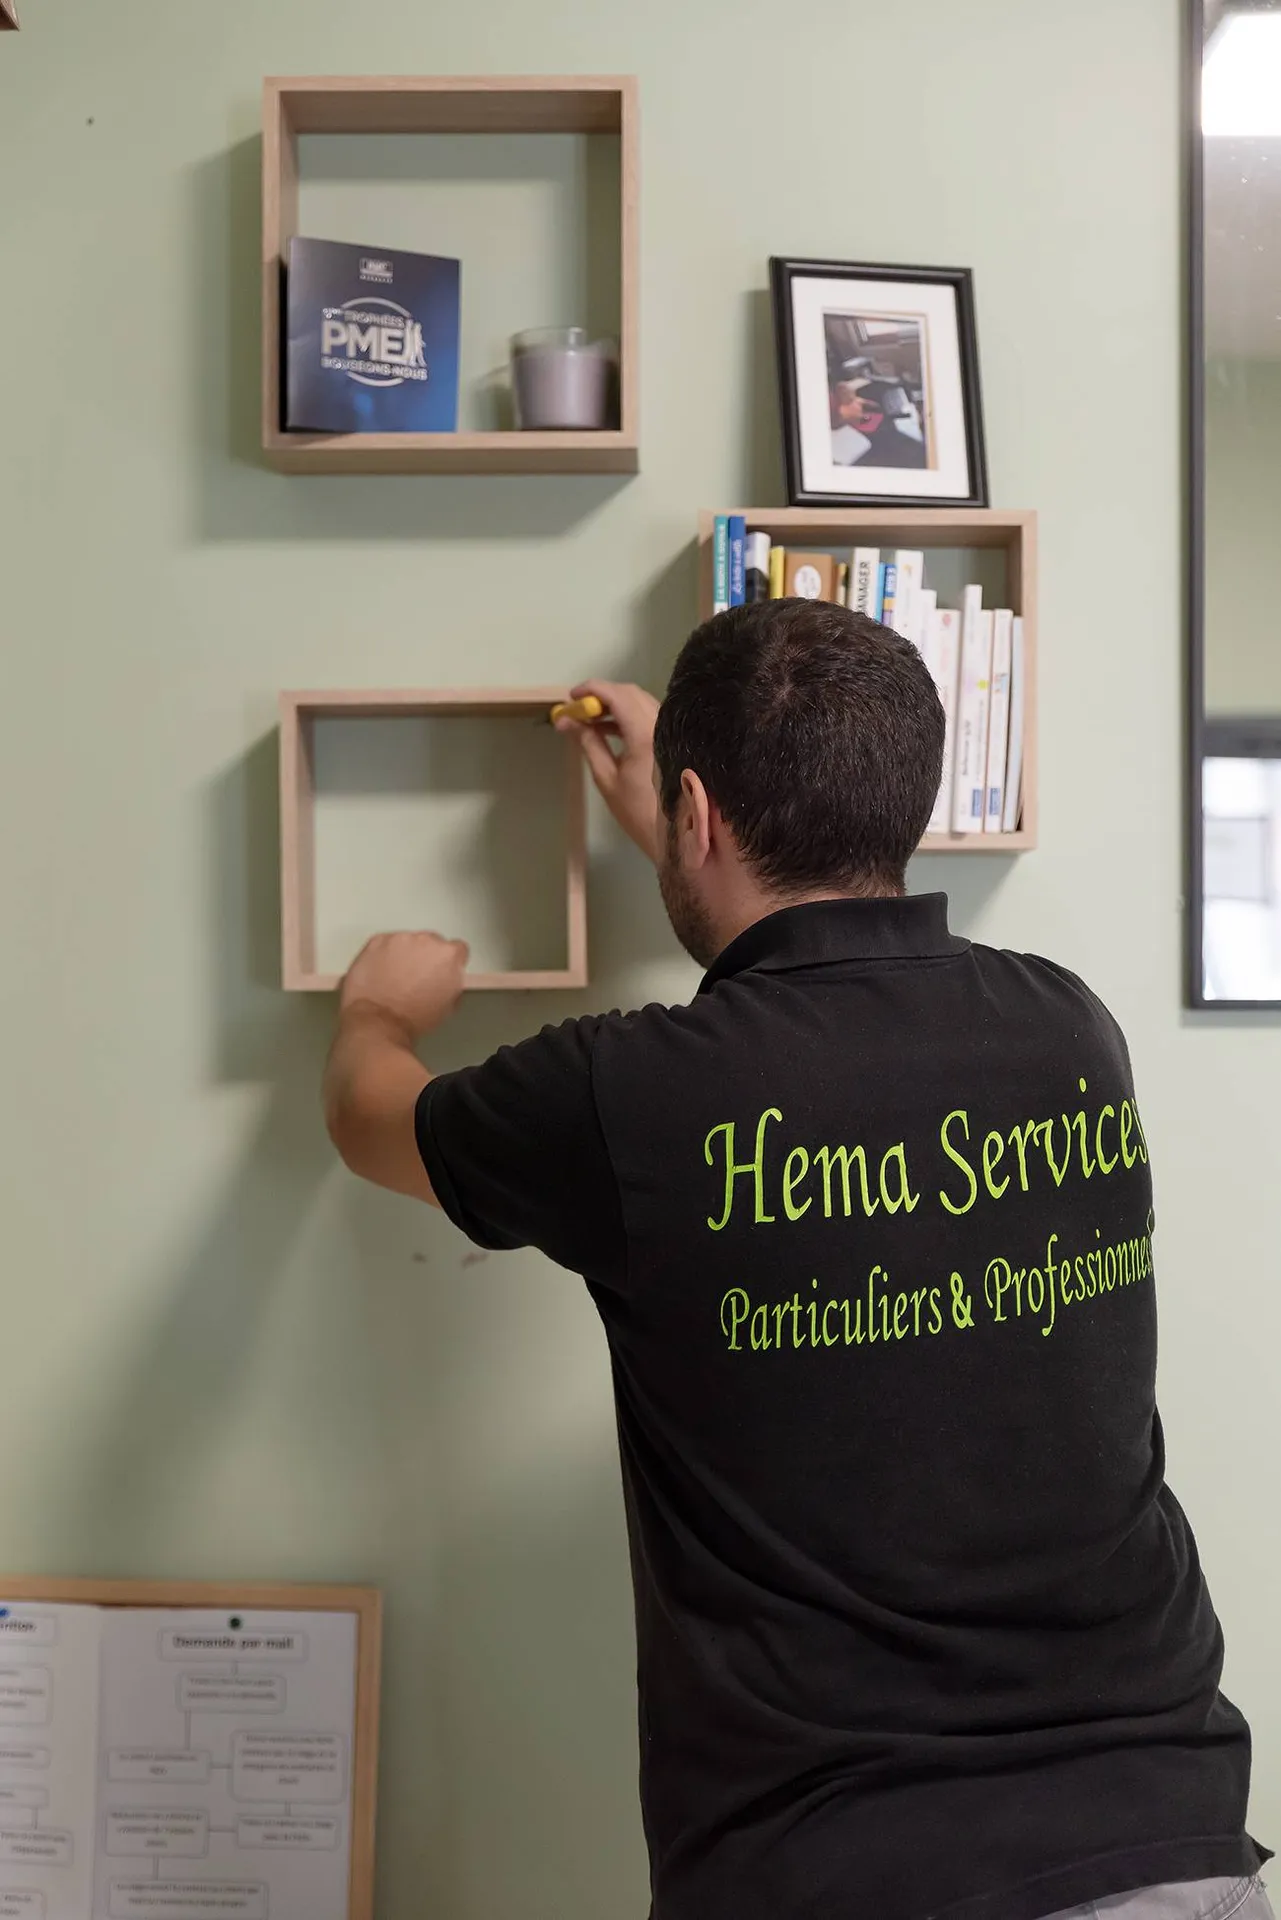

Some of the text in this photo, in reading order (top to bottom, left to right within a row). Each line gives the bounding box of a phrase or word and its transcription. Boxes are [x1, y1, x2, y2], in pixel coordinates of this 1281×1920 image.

[321, 319, 411, 365] PME
[857, 560, 871, 611] ANAGER
[704, 1077, 1149, 1231] Hema Services
[720, 1264, 942, 1352] Particuliers
[950, 1271, 975, 1330] &
